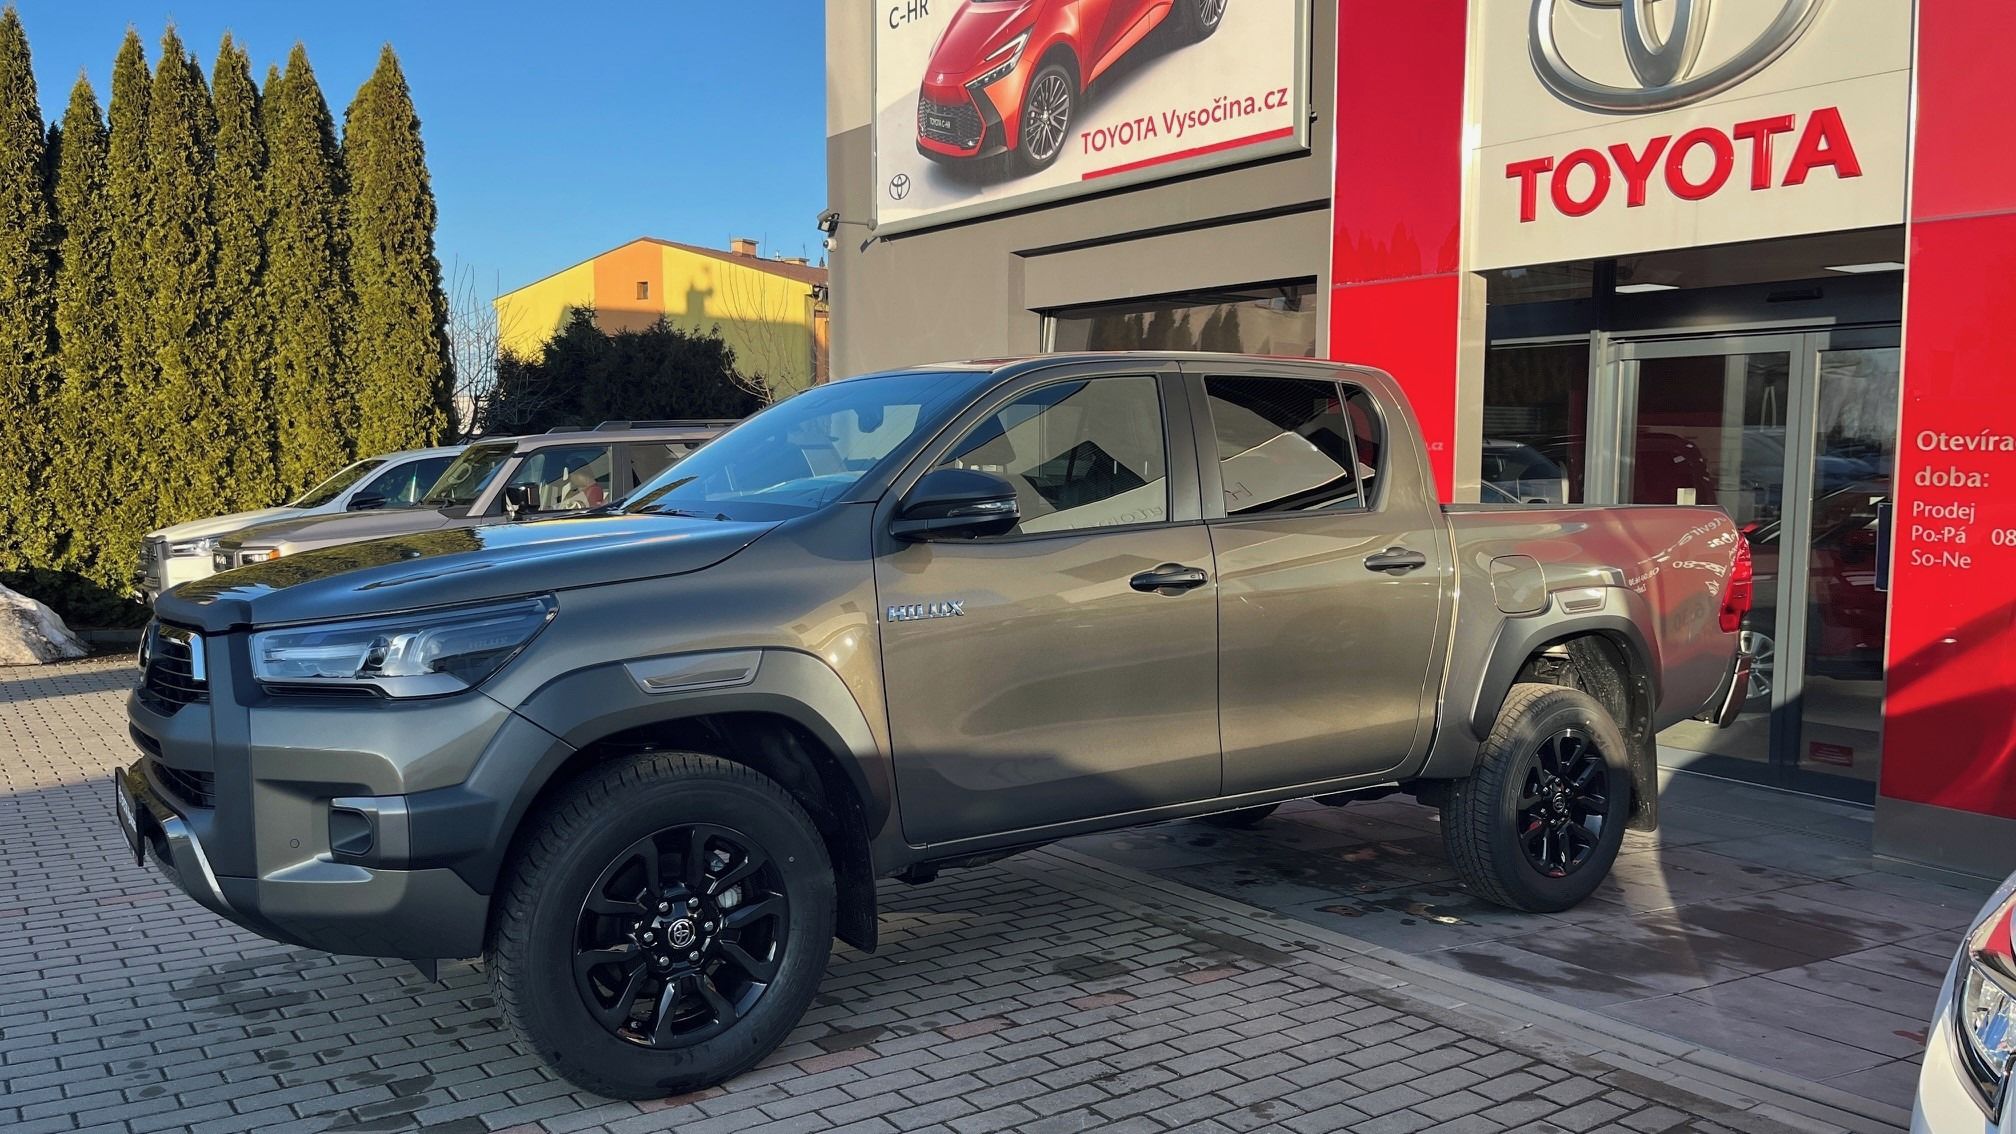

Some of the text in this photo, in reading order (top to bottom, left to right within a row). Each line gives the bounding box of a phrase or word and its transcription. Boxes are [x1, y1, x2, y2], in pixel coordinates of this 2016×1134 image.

[889, 0, 929, 29] C-HR
[1081, 87, 1288, 154] TOYOTA Vysočina.cz
[1506, 106, 1862, 223] TOYOTA
[1916, 429, 2016, 451] Otevíra
[1914, 466, 1989, 487] doba:
[1912, 501, 1975, 524] Prodej
[1911, 549, 1972, 568] So-Ne
[888, 600, 965, 622] HILUX
